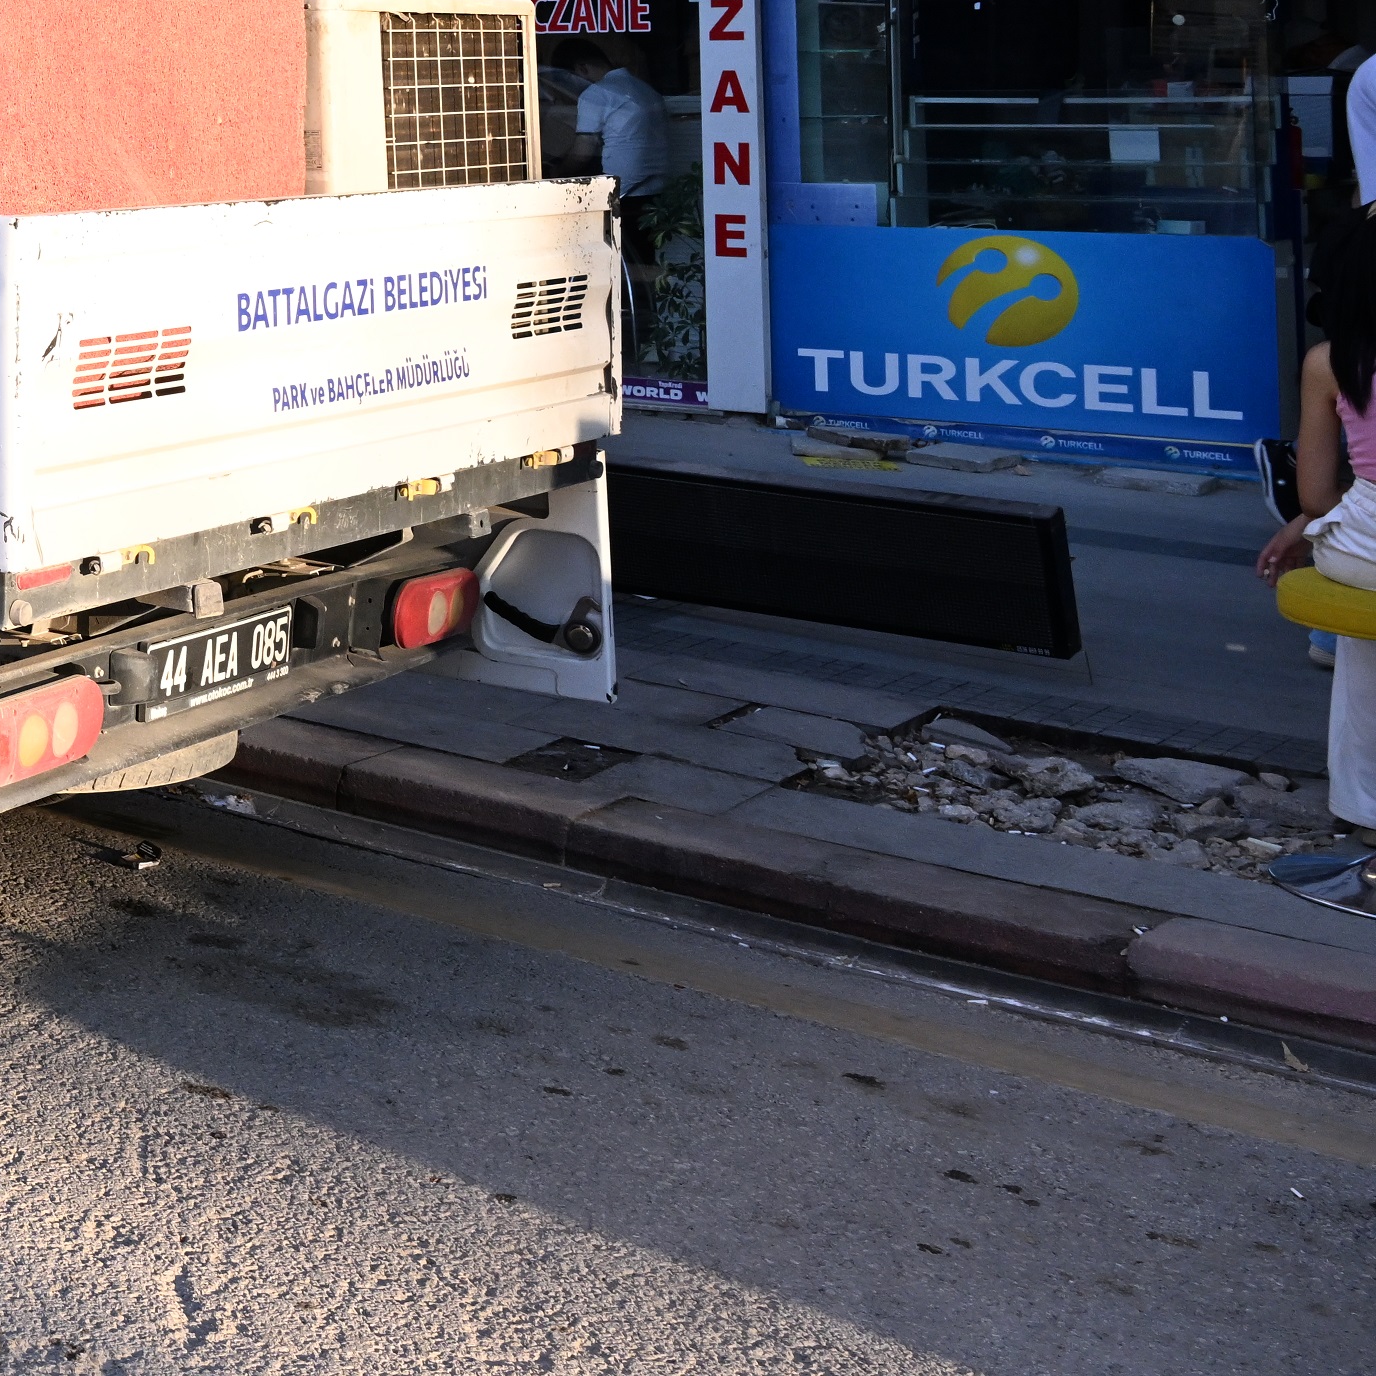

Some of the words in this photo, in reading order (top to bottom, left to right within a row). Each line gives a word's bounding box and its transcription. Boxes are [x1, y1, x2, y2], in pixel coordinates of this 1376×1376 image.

[272, 380, 308, 412] PARK
[310, 387, 325, 406] ve
[327, 371, 394, 406] BAHÇELER
[797, 348, 1244, 422] TURKCELL
[940, 429, 984, 440] TURKCELL
[1058, 439, 1104, 451] TURKCELL
[1183, 448, 1233, 462] TURKCELL
[160, 646, 187, 696] 44
[201, 632, 237, 686] AEA
[251, 616, 288, 669] 085
